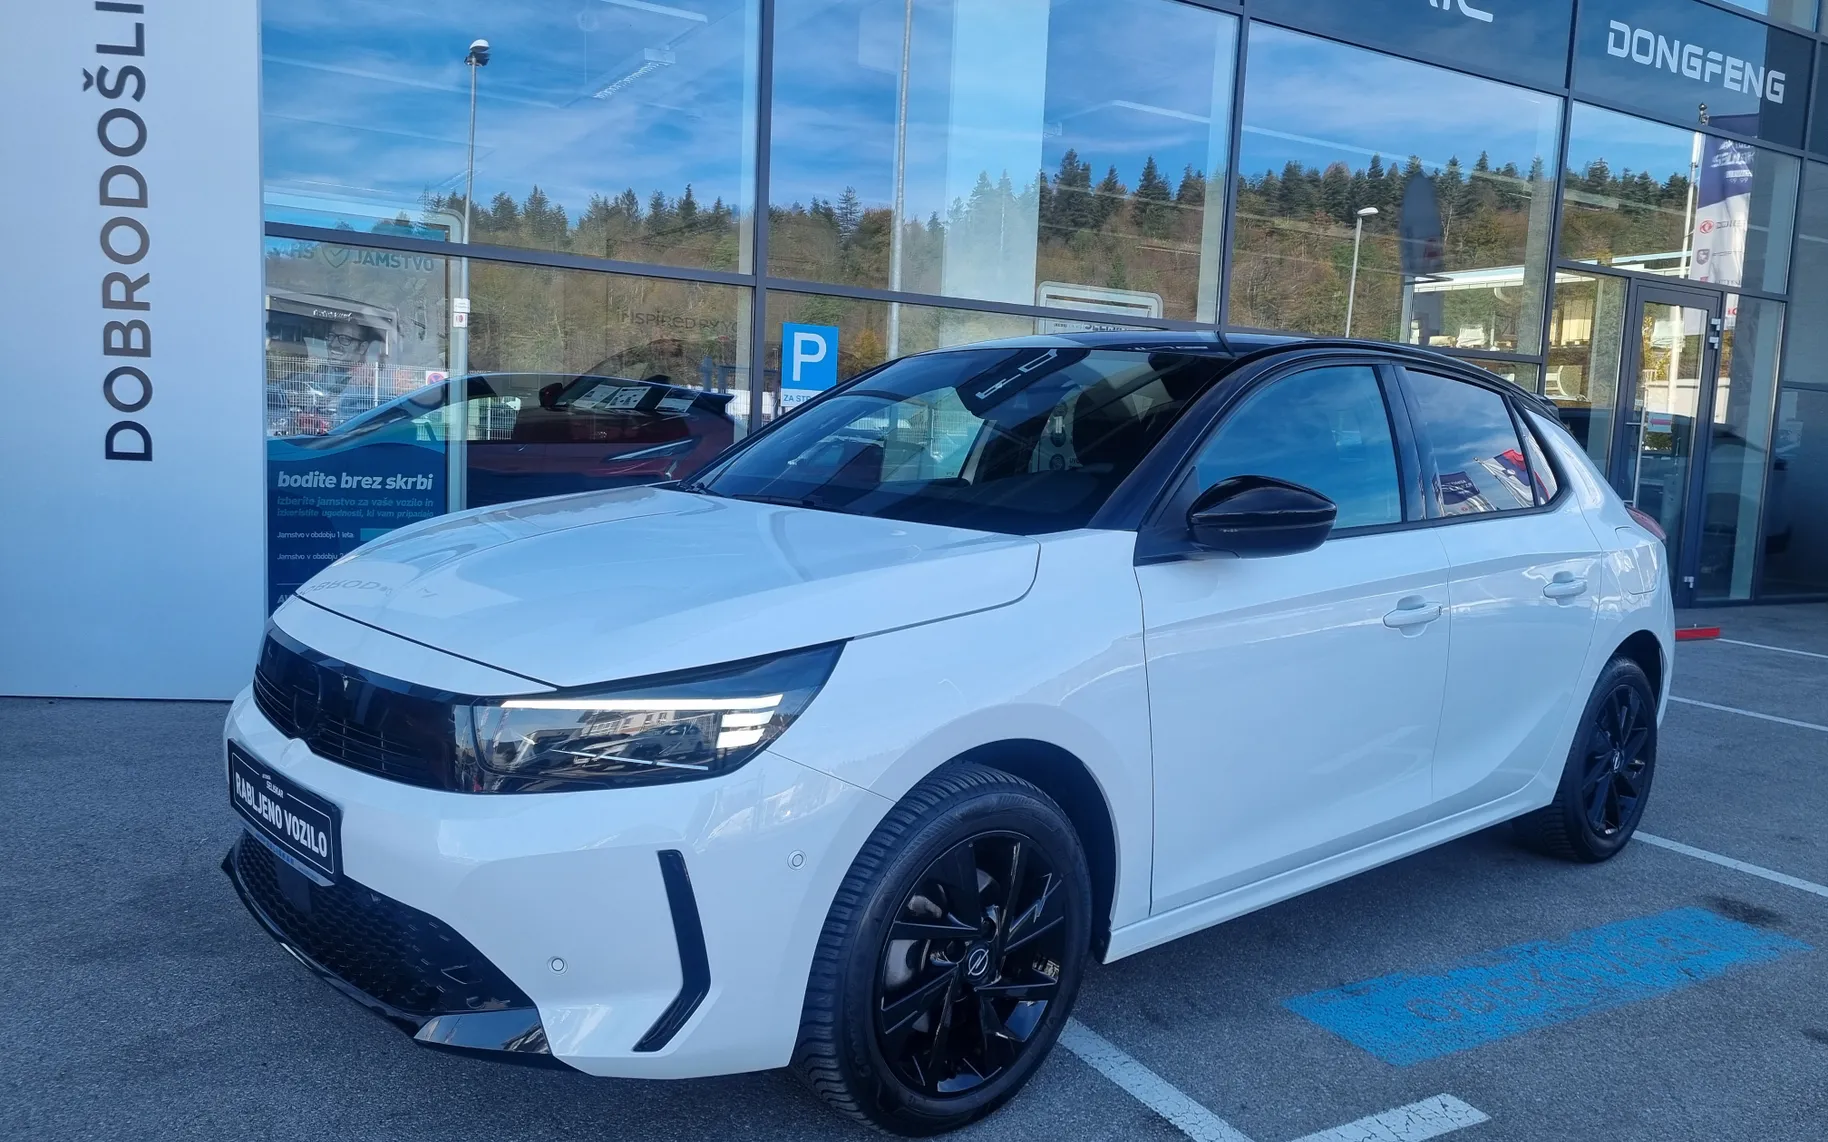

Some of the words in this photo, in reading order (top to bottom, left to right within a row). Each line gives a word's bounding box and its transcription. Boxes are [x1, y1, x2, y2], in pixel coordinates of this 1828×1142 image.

[1607, 19, 1786, 104] DONGFENG
[82, 1, 153, 462] DOBRODOŠLI
[352, 249, 435, 272] JAMSTVO
[792, 331, 827, 382] P
[783, 394, 795, 402] ZA
[277, 470, 337, 488] bodite
[340, 472, 383, 489] brez
[385, 473, 434, 490] skrbi
[276, 495, 316, 506] izberite
[316, 496, 356, 508] jamstvo
[357, 499, 369, 507] za
[371, 497, 394, 507] vaše
[395, 498, 423, 507] vozilo
[424, 498, 434, 507] in
[366, 509, 375, 517] ki
[276, 531, 305, 539] Jamstvo
[310, 531, 336, 540] obdobju
[276, 553, 305, 561] Jamstvo
[312, 553, 338, 562] obdobju
[235, 771, 283, 830] RABLJENO
[283, 809, 328, 858] VOZILO
